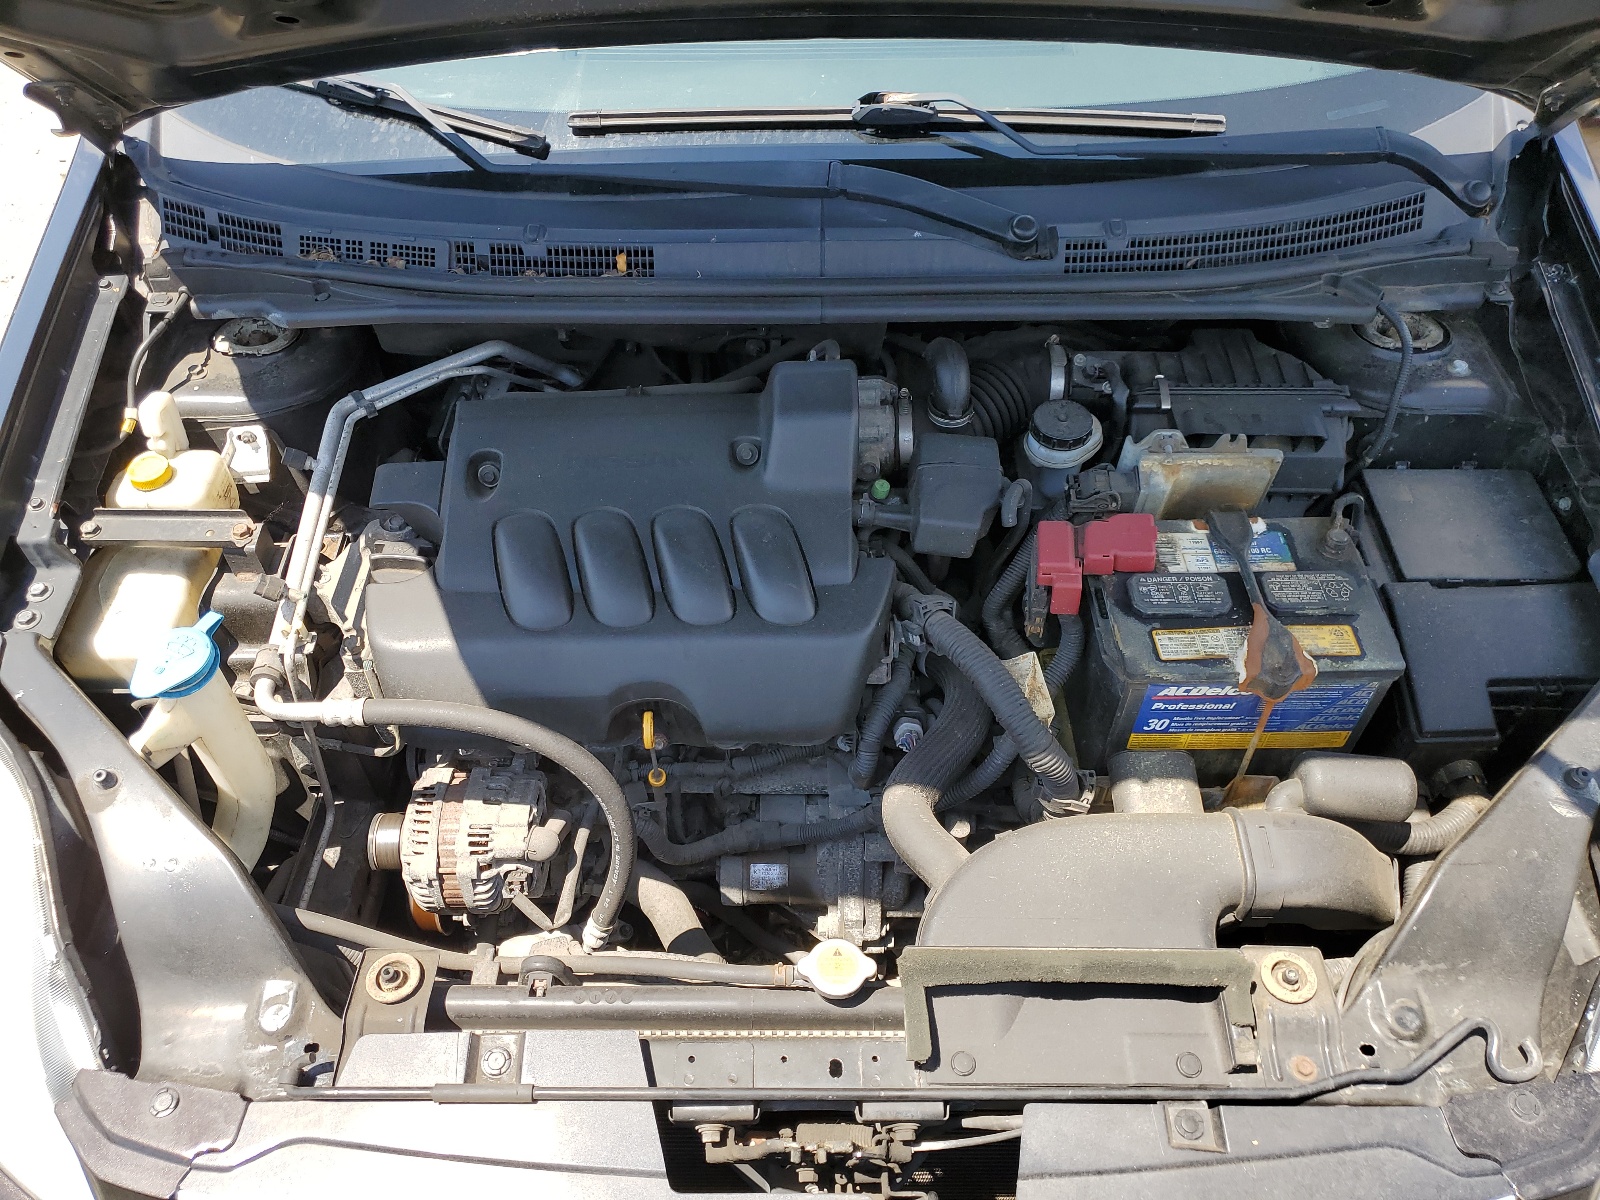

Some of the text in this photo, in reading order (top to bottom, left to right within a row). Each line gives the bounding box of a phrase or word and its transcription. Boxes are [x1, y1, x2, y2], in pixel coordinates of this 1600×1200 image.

[1146, 575, 1178, 583] DANGER
[1151, 702, 1237, 711] Professional
[1143, 718, 1171, 731] 30
